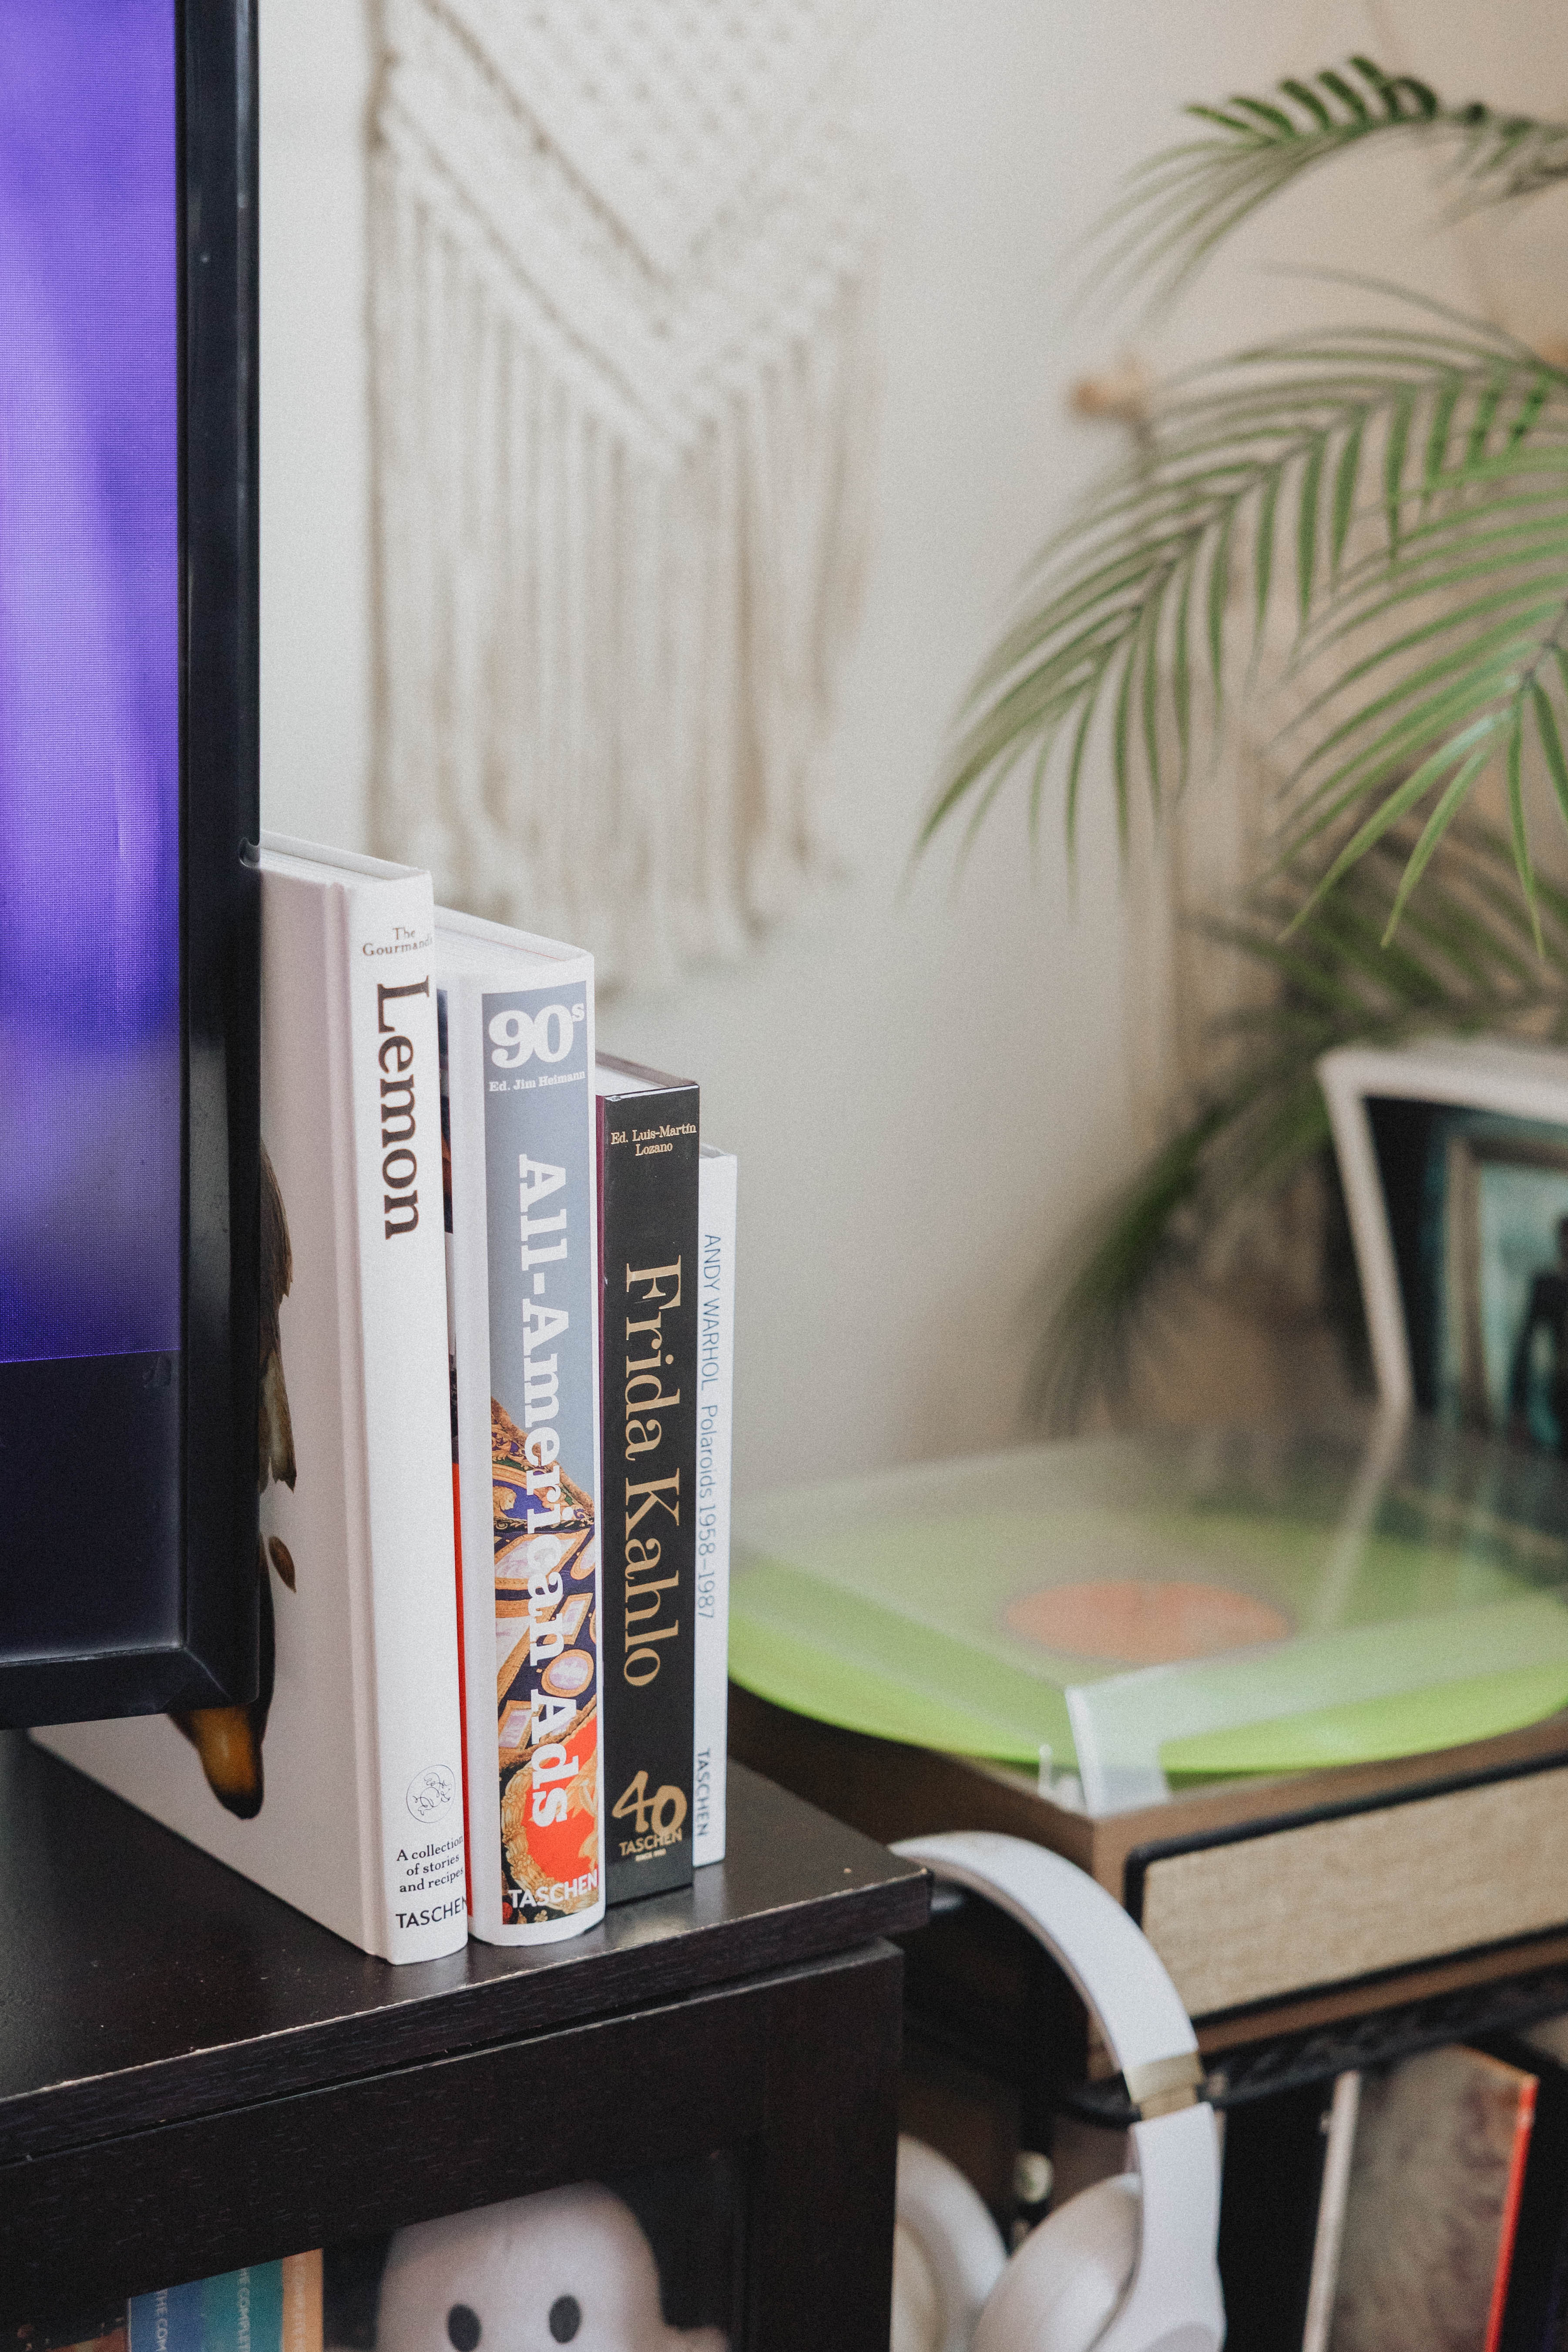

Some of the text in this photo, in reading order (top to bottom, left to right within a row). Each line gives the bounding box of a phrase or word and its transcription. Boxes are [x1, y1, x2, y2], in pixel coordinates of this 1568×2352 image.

[393, 927, 415, 940] The
[489, 1003, 585, 1068] 90s
[489, 1071, 586, 1092] Ed. Jim Heimann
[377, 975, 430, 1240] Lemon
[611, 1123, 697, 1144] Ed. Luis-Martín
[635, 1143, 673, 1156] Lozano
[703, 1234, 721, 1290] ANDY
[702, 1298, 719, 1391] WARHOL
[625, 1254, 682, 1687] Frida Kahlo
[699, 1404, 718, 1499] Polaroids
[519, 1153, 580, 1827] All-American Ads
[612, 1771, 687, 1837] 40
[697, 1747, 710, 1837] TASCHEN
[396, 1836, 463, 1861] A collection
[406, 1855, 460, 1876] of stories
[618, 1828, 682, 1856] TASCHEN
[400, 1867, 463, 1892] and recipes
[508, 1868, 598, 1908] TASCHEN
